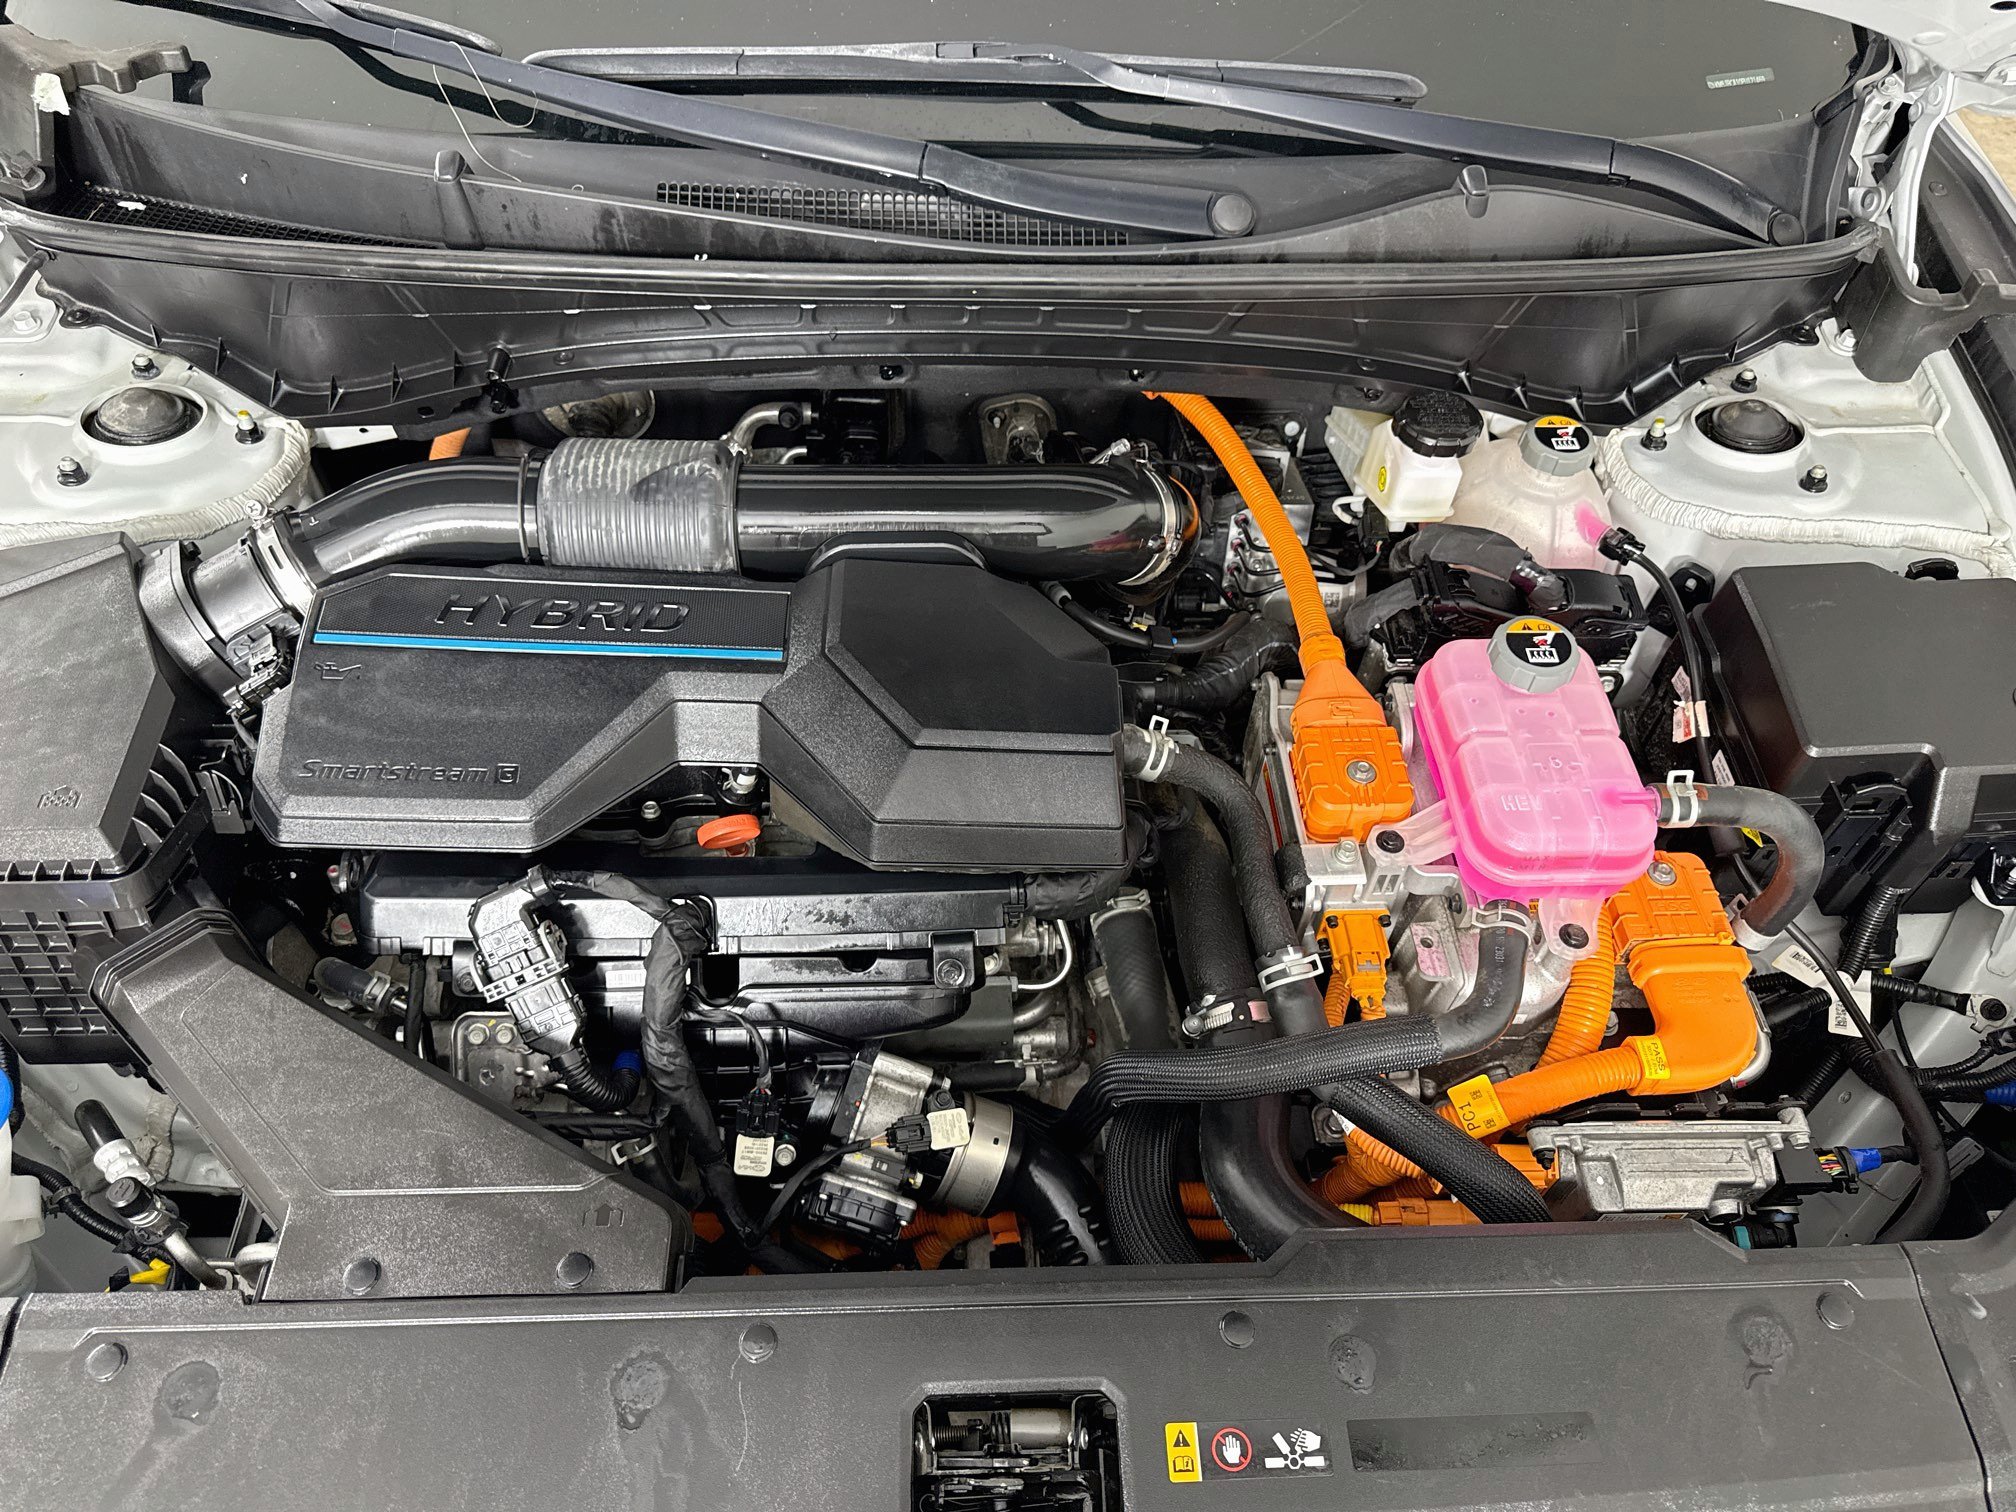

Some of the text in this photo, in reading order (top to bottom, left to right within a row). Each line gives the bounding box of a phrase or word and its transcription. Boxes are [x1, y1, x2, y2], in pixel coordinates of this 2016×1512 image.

[434, 593, 690, 633] HYBRID
[298, 759, 489, 782] Smartstream
[1650, 1042, 1666, 1072] PASS
